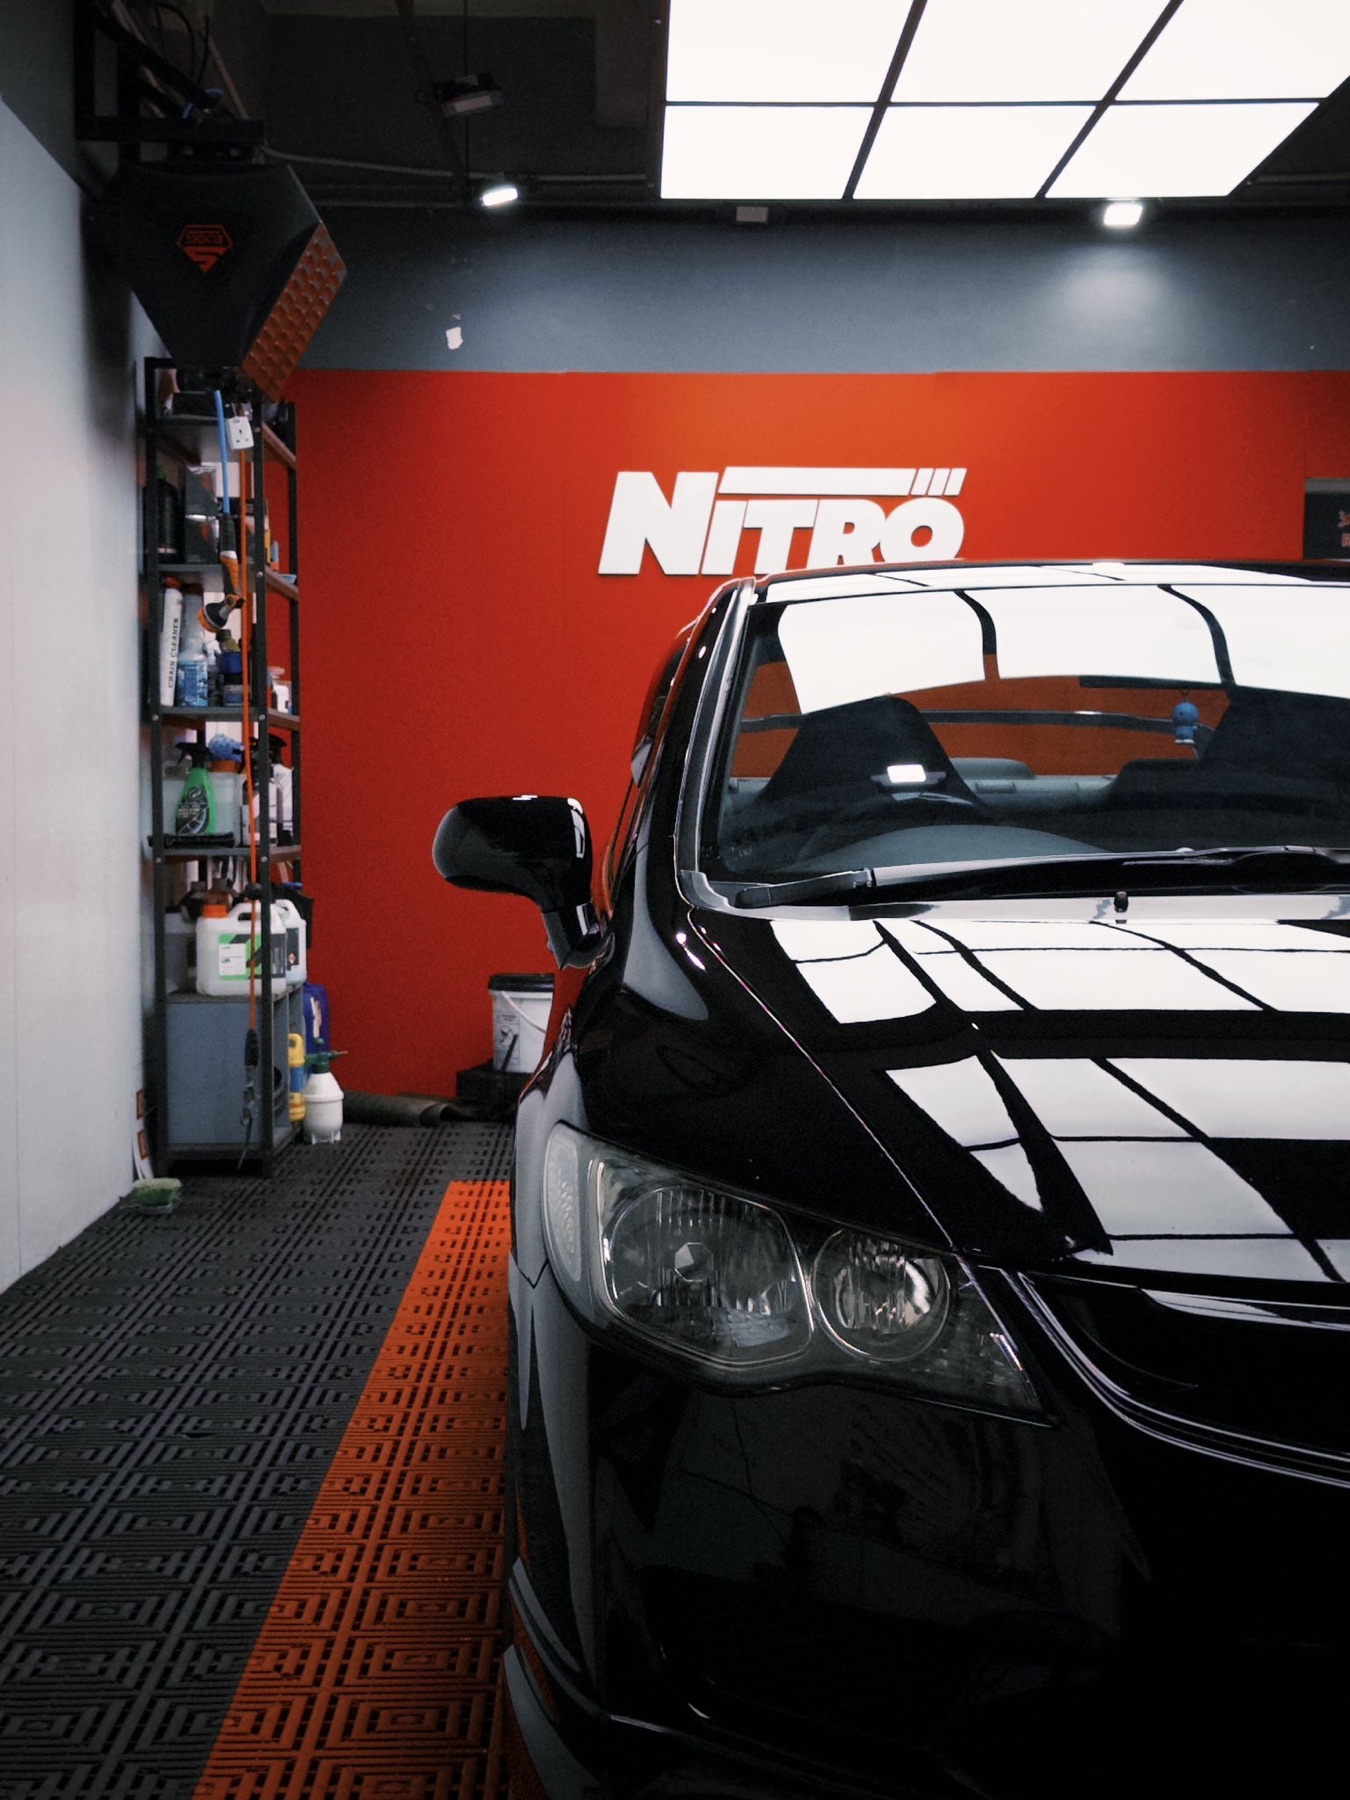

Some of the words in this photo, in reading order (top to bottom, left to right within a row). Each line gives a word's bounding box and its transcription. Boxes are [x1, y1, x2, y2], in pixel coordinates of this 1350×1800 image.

[598, 470, 965, 575] NITRO
[170, 618, 179, 658] CLEANER
[168, 661, 176, 688] CHAIN
